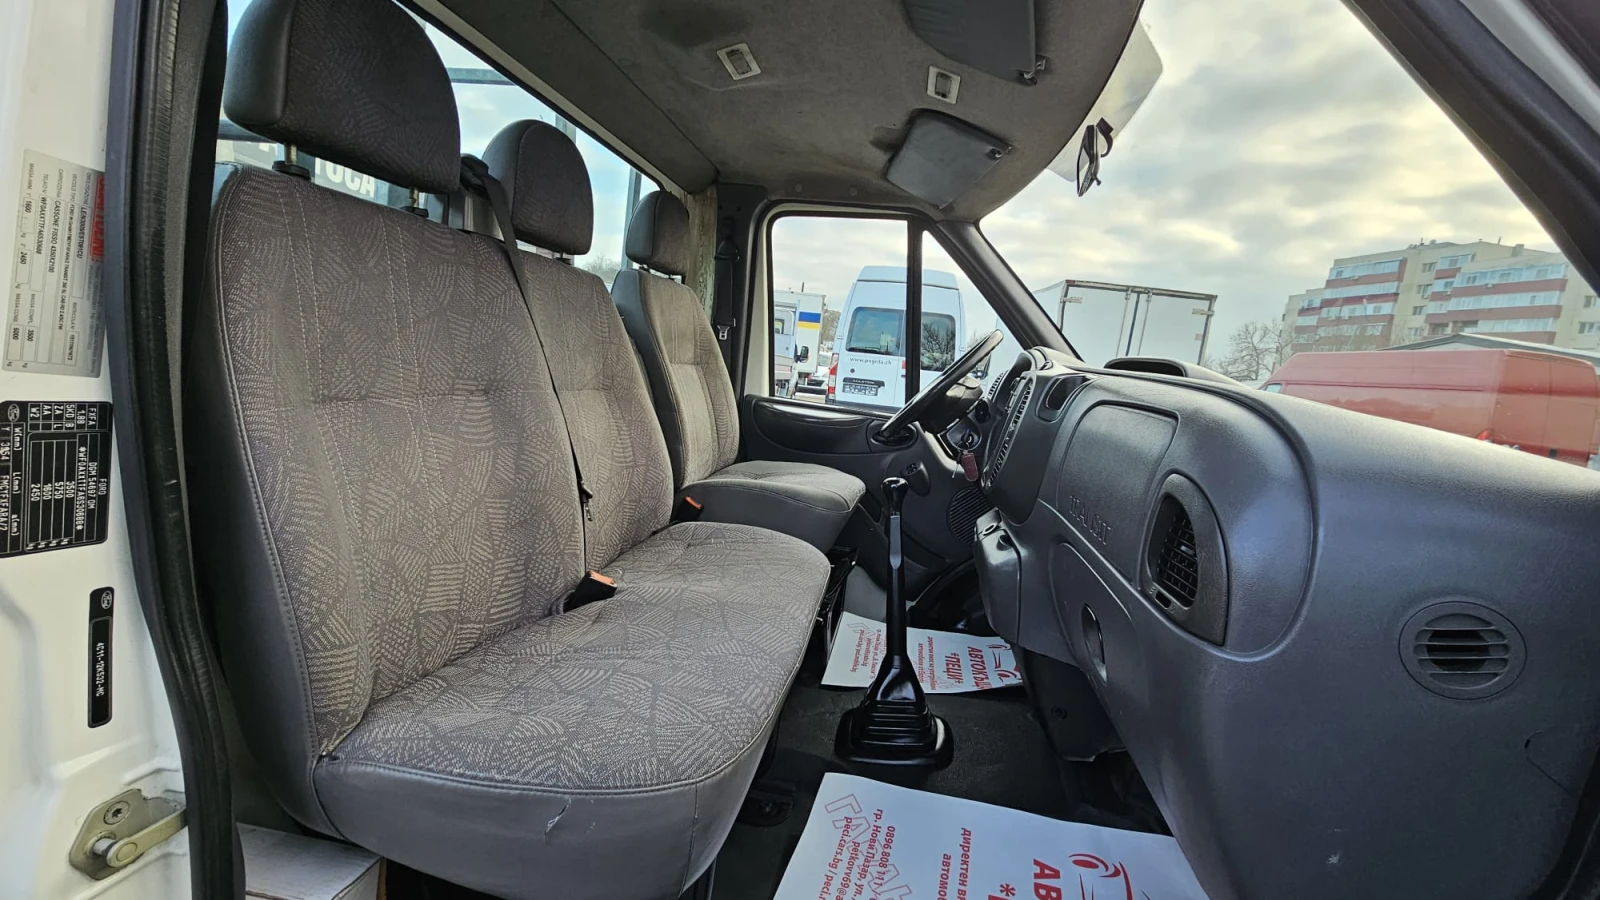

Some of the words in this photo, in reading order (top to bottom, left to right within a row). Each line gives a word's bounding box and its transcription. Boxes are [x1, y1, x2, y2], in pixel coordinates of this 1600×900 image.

[52, 200, 61, 227] CASSONE
[48, 245, 57, 273] 4350X2100
[30, 407, 39, 418] W2
[42, 405, 52, 415] AA
[54, 405, 63, 414] ZA
[88, 408, 96, 425] FXFA
[88, 462, 97, 475] DGM
[30, 484, 40, 501] 2450
[54, 481, 64, 499] 5750
[66, 481, 75, 498] 3500
[87, 477, 96, 497] 54697
[98, 478, 107, 495] FORD
[968, 646, 992, 690] АВТОКЪЩ
[873, 809, 884, 822] гр.
[828, 816, 853, 869] peci.cars.bg
[867, 824, 882, 850] Нови
[883, 826, 896, 850] 0896
[878, 851, 890, 868] 808
[959, 827, 972, 887] директен
[857, 851, 875, 881] Пазар,
[873, 871, 886, 886] 111
[853, 882, 864, 897] ул.
